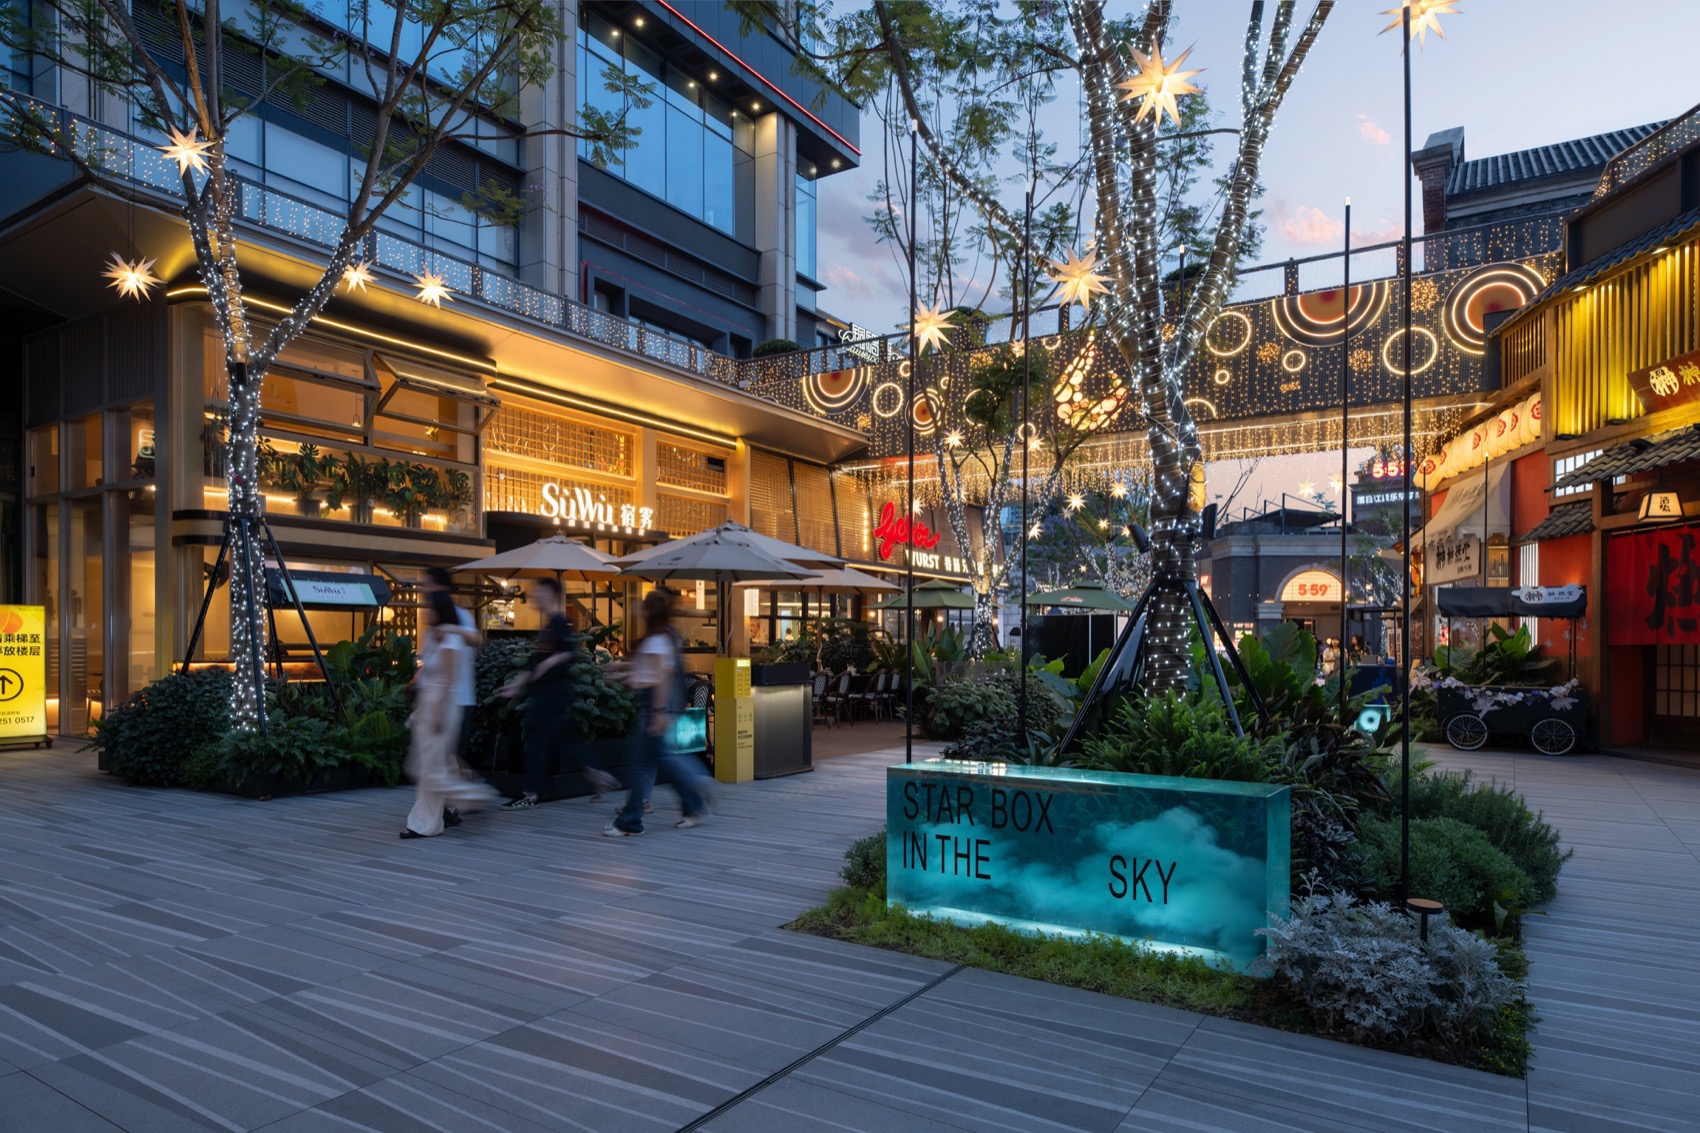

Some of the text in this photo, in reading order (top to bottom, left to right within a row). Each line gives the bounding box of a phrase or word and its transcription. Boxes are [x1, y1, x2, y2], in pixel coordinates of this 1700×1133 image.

[0, 633, 41, 643] 乘梯至
[14, 716, 35, 724] 0517
[903, 781, 1055, 835] STAR BOX
[903, 831, 991, 880] IN THE
[1108, 854, 1177, 904] SKY
